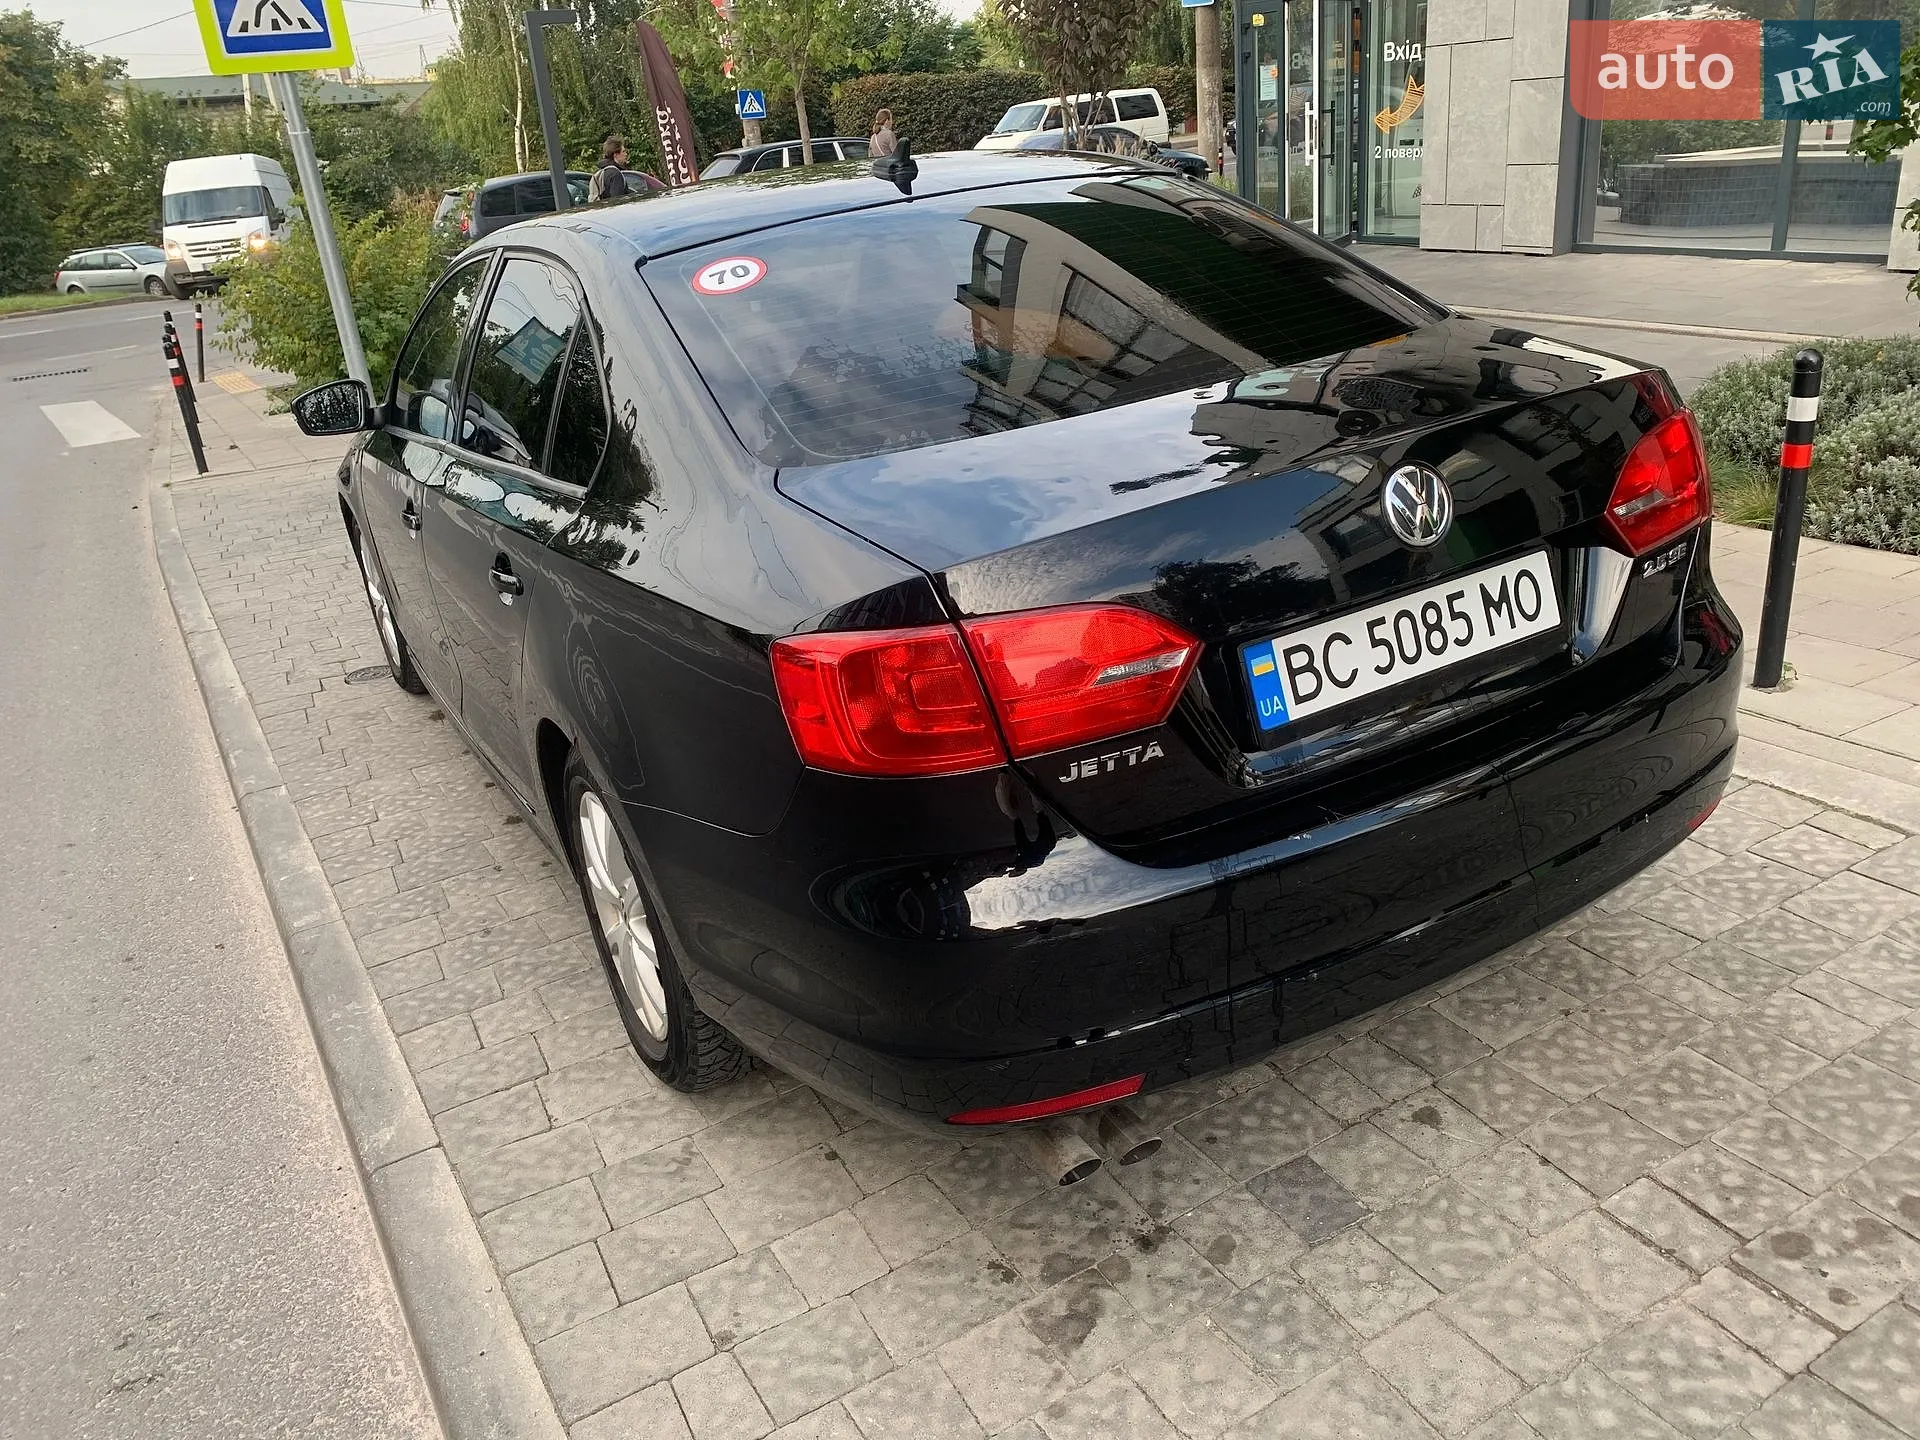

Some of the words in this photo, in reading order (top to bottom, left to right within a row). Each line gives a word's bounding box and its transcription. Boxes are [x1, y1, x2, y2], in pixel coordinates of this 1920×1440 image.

[1384, 40, 1422, 62] Вхід
[1374, 145, 1382, 159] 2
[709, 265, 750, 284] 70
[1282, 632, 1358, 705] BC
[1366, 590, 1473, 675] 5085
[1479, 569, 1542, 636] MO
[1260, 695, 1284, 717] UA
[1059, 741, 1164, 782] JETTA
